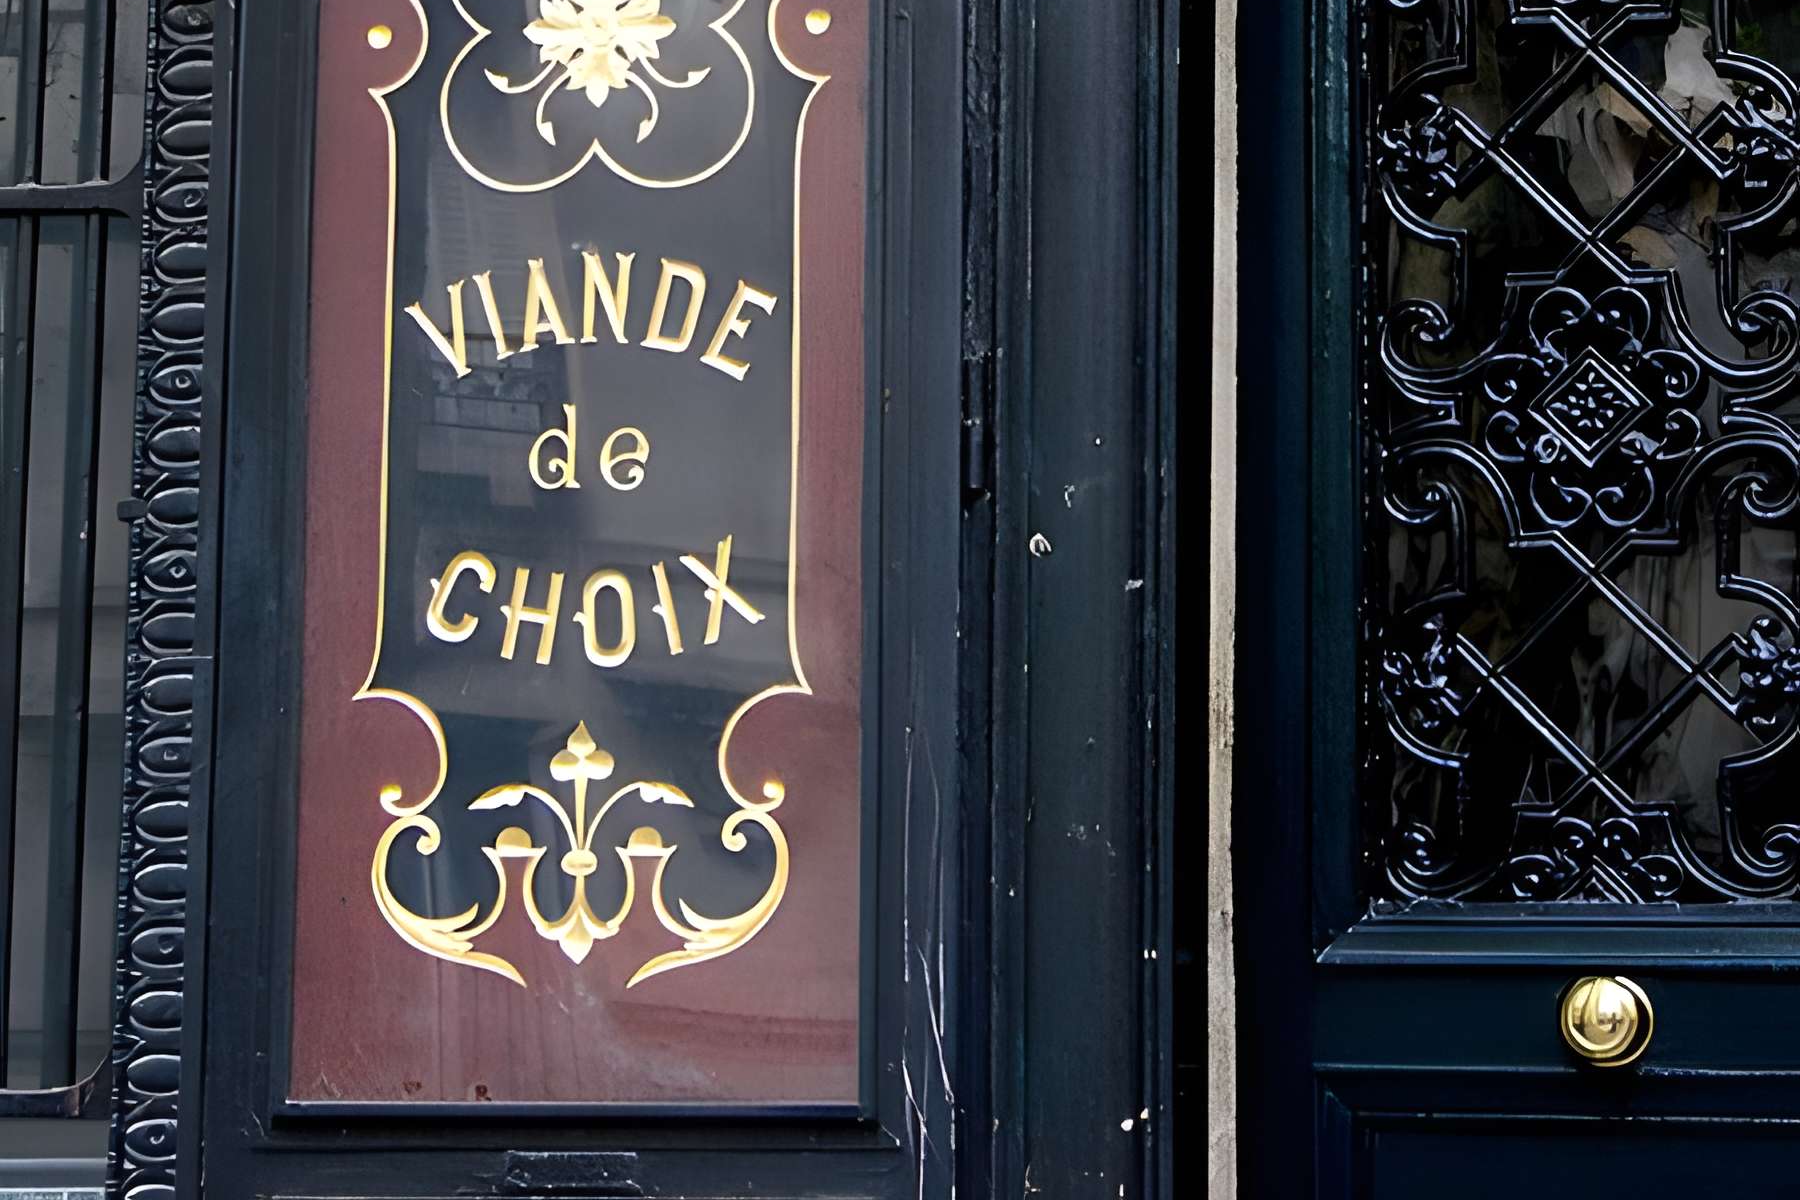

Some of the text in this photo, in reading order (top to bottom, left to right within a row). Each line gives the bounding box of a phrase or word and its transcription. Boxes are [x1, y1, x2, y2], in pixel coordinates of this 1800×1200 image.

[404, 250, 777, 381] VIANDE
[528, 403, 651, 490] de
[426, 534, 765, 667] CHOIX
